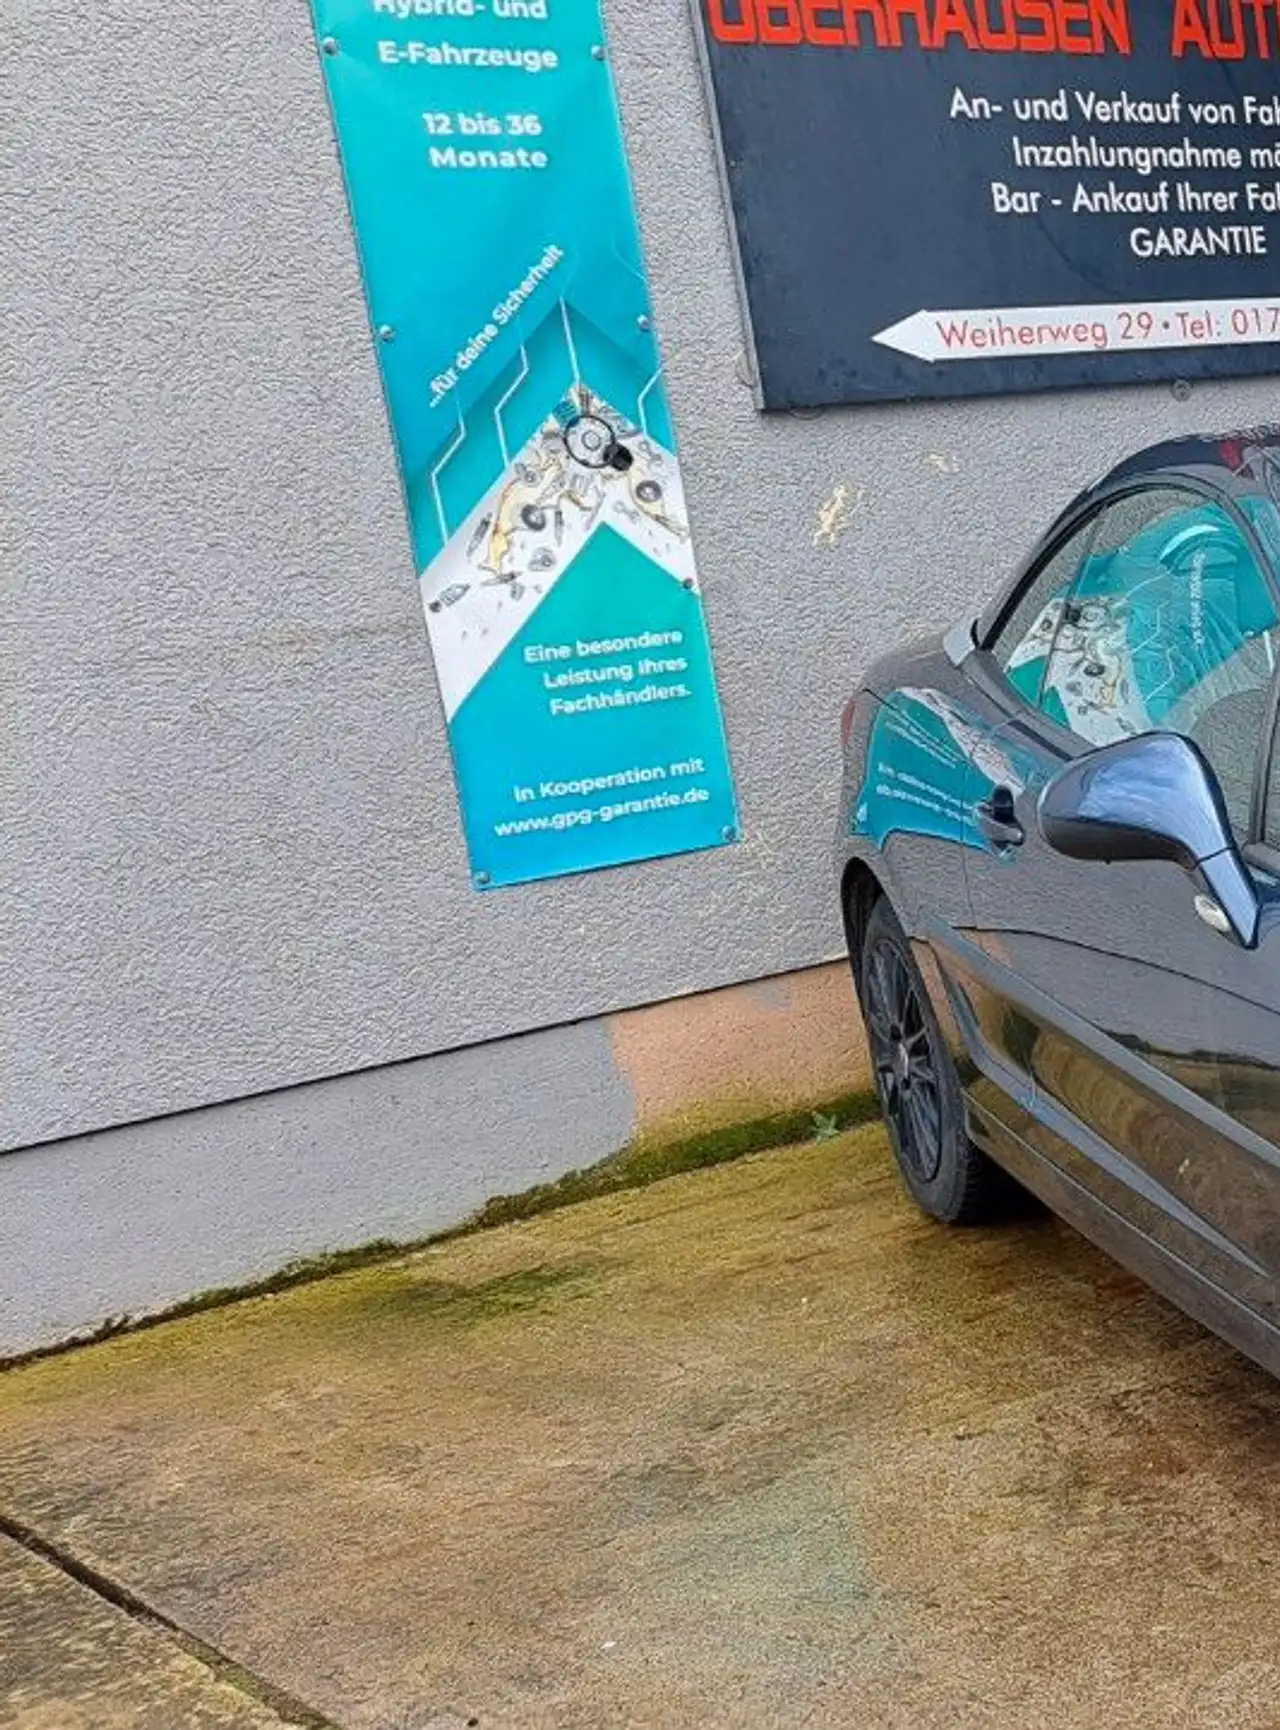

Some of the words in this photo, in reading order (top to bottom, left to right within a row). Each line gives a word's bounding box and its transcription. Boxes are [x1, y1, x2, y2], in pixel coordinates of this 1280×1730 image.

[374, 0, 486, 18] Hybrid-
[708, 0, 1132, 56] OBERHAUSEN
[377, 40, 558, 73] E-Fahrzeuge
[950, 86, 1002, 119] An-
[1013, 89, 1068, 121] und
[1075, 90, 1180, 123] Verkauf
[1189, 104, 1236, 124] von
[422, 113, 452, 136] 12
[458, 113, 500, 136] bis
[505, 114, 542, 137] 36
[428, 146, 548, 169] Monate
[1013, 136, 1242, 176] Inzahlungnahme
[991, 182, 1040, 213] Bar
[1072, 181, 1169, 213] Ankauf
[1178, 181, 1238, 212] Ihrer
[1130, 225, 1268, 258] GARANTIE
[454, 321, 499, 373] deine
[492, 243, 565, 324] Sicherheit
[936, 317, 1108, 349] Weiherweg
[1118, 312, 1153, 340] 29
[1176, 310, 1221, 338] Tel:
[523, 643, 571, 664] Eine
[576, 628, 684, 656] besondere
[543, 662, 634, 689] Leistung
[638, 655, 688, 676] Ihres
[550, 682, 691, 716] Fachhändlers.
[513, 785, 535, 803] In
[539, 764, 667, 800] Kooperation
[670, 757, 705, 777] mit
[494, 787, 710, 837] www.gpg-garantie.de
